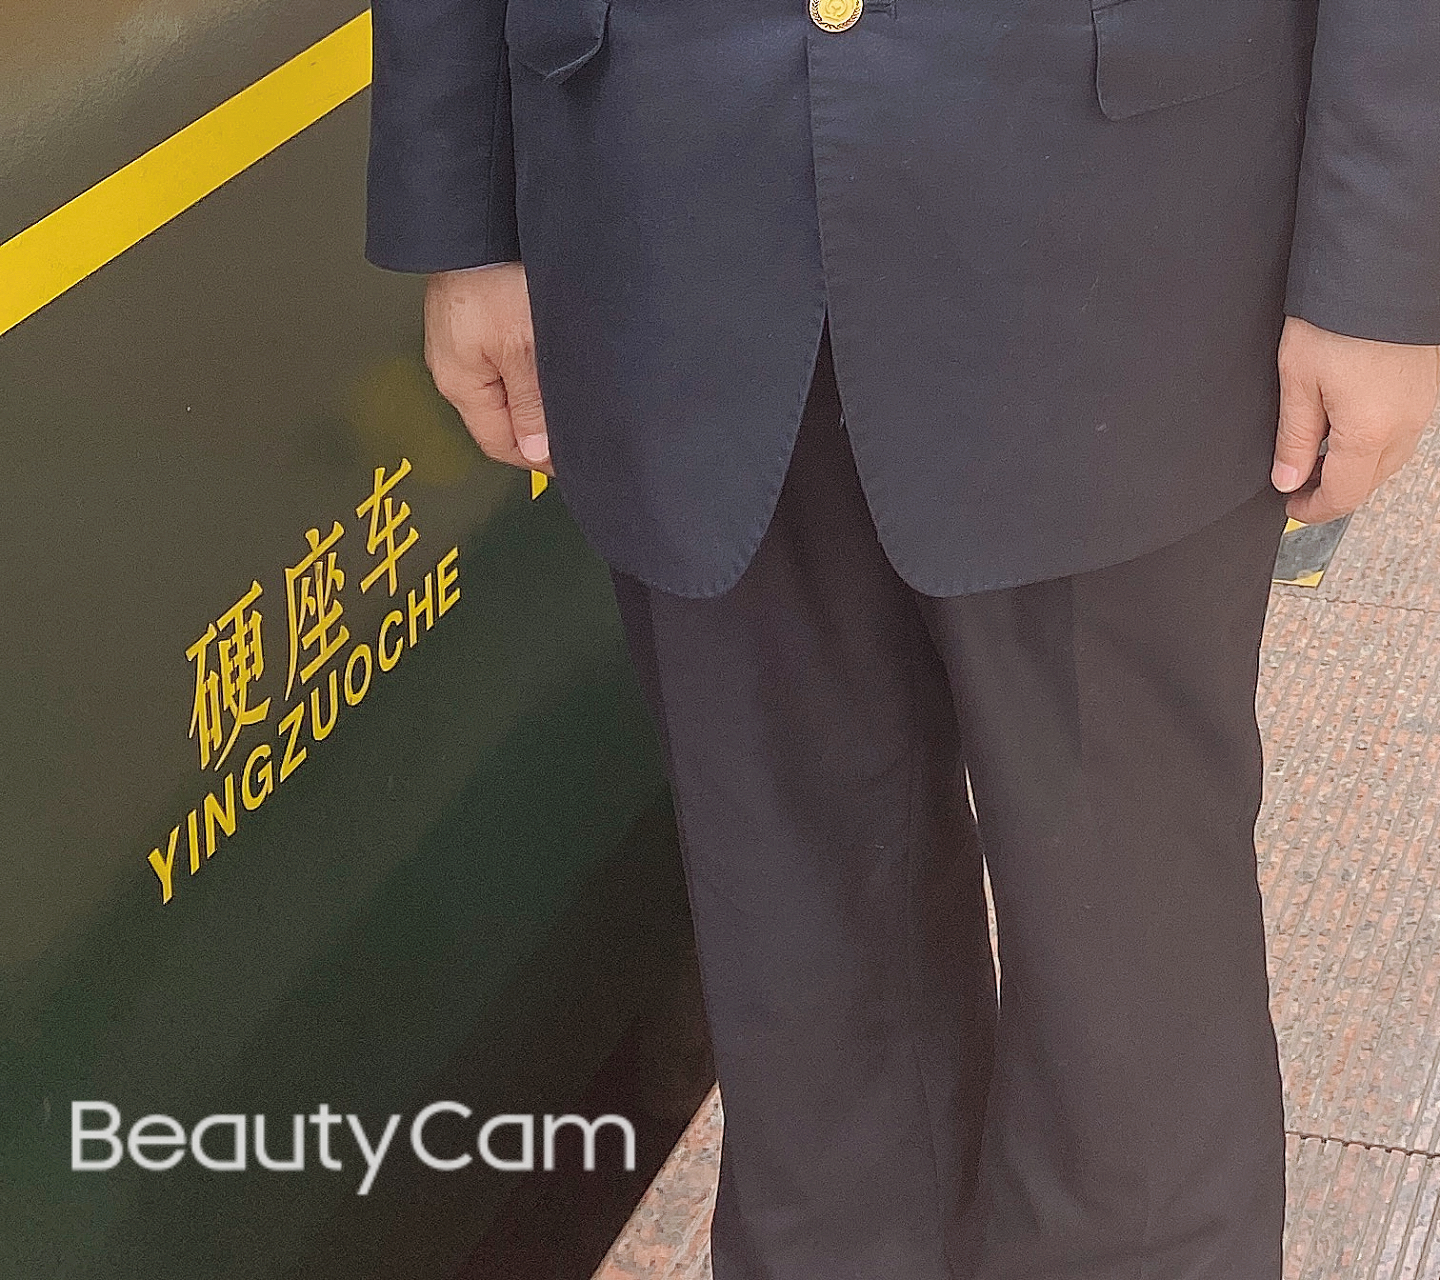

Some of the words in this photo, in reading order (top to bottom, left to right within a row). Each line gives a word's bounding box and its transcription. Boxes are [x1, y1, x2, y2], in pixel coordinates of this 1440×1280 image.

[146, 545, 463, 906] YINGZUOCHE
[184, 457, 420, 772] 硬座车
